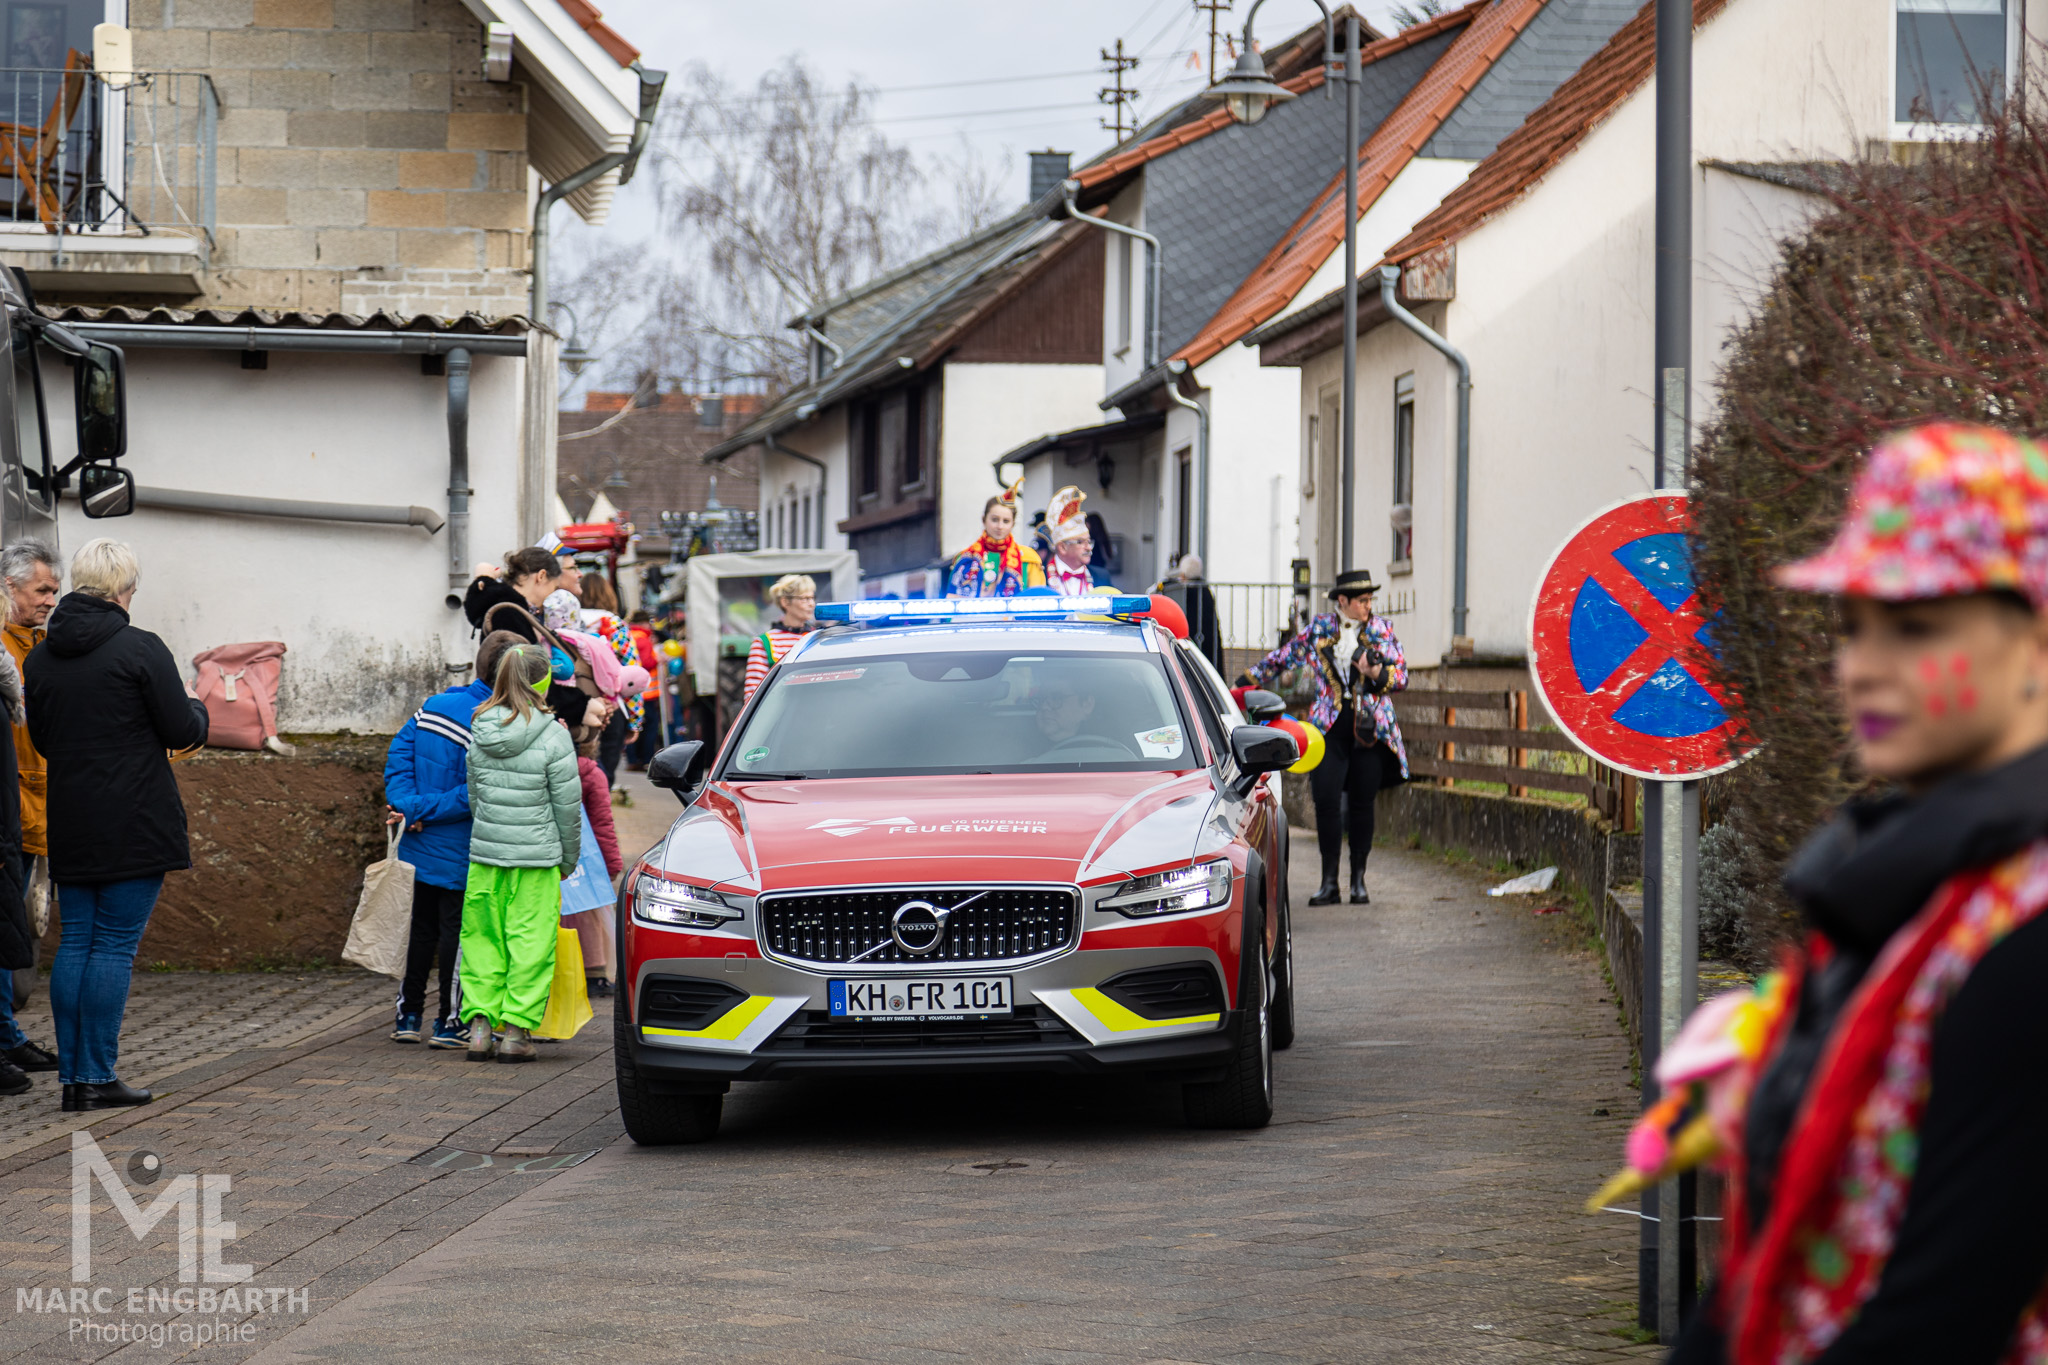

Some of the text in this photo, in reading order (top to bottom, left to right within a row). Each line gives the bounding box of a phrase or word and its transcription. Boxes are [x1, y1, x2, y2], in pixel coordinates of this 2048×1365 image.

[972, 818, 1047, 826] RÜDESHEIM
[888, 825, 1047, 834] FEUERWEHR
[835, 981, 1008, 1011] D KH FR 101
